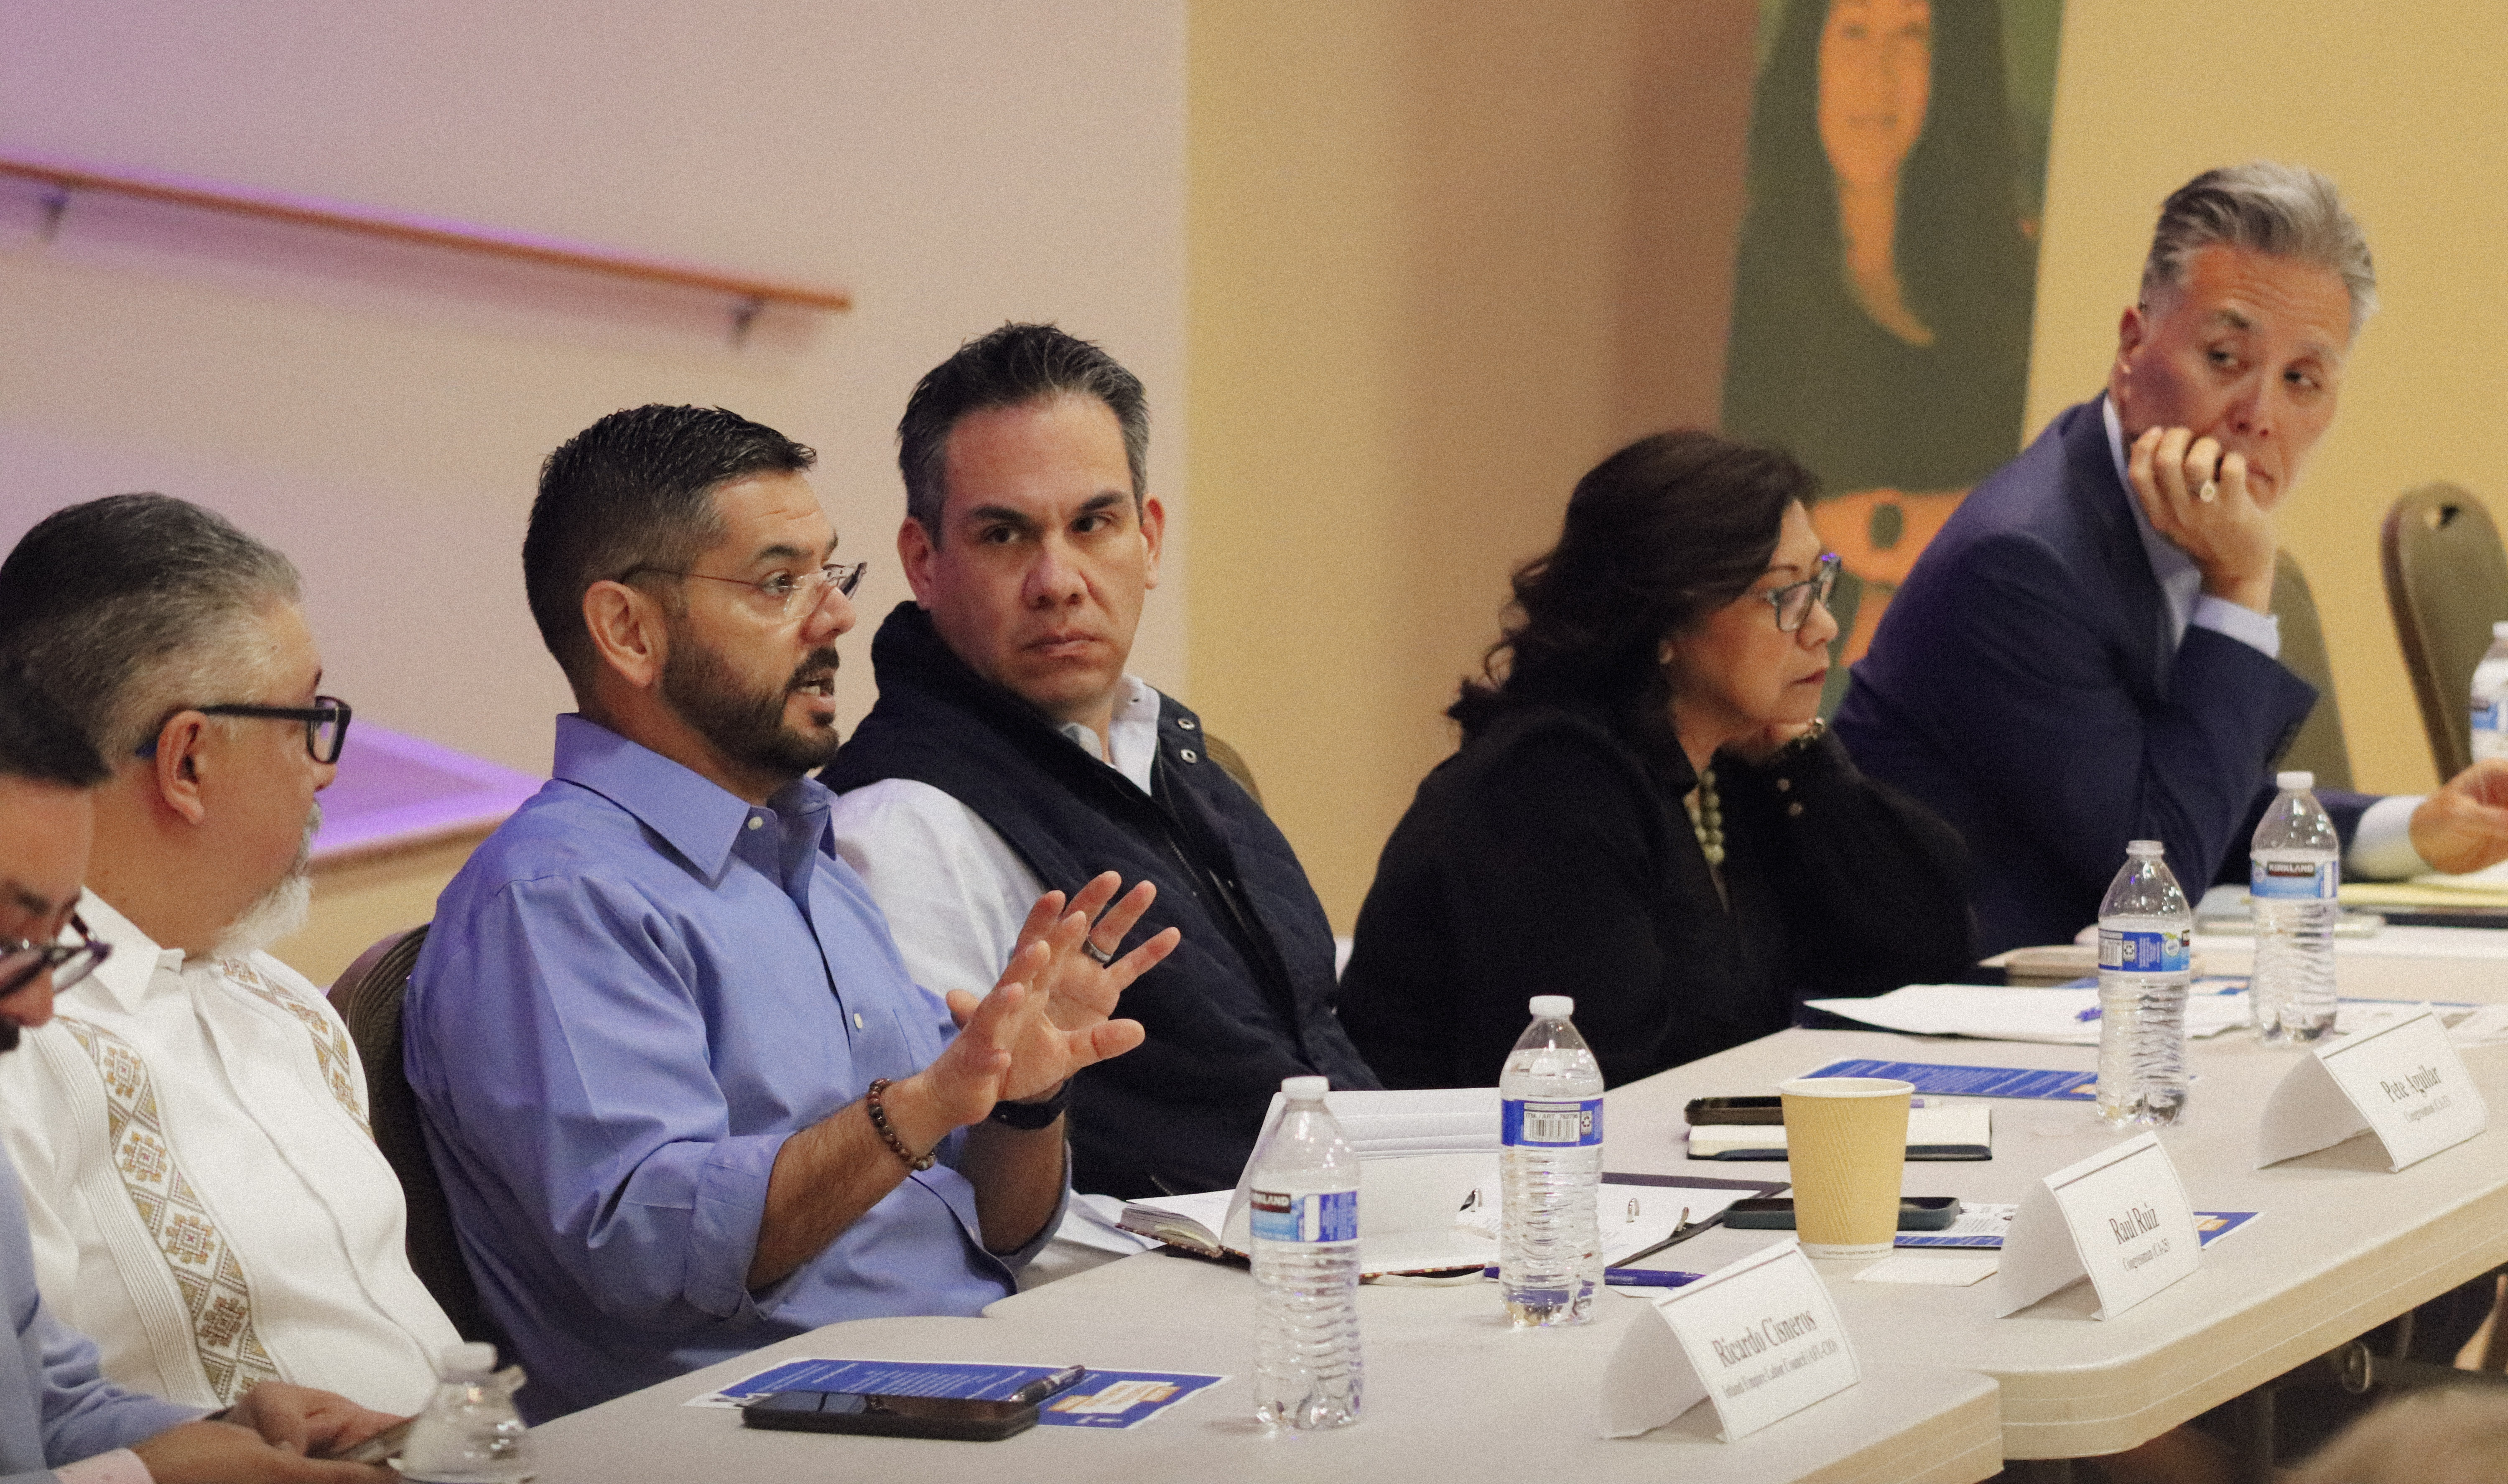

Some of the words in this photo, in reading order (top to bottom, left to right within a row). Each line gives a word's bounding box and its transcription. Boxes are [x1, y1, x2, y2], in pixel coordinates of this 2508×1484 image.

[2268, 863, 2313, 872] KIRKLAND
[2380, 1080, 2409, 1103] Pete
[2404, 1065, 2442, 1098] Aguilar
[2108, 1211, 2139, 1245] Raul
[2131, 1202, 2160, 1234] Ruiz
[1711, 1326, 1767, 1368] Ricardo
[1761, 1310, 1817, 1347] Cisneros
